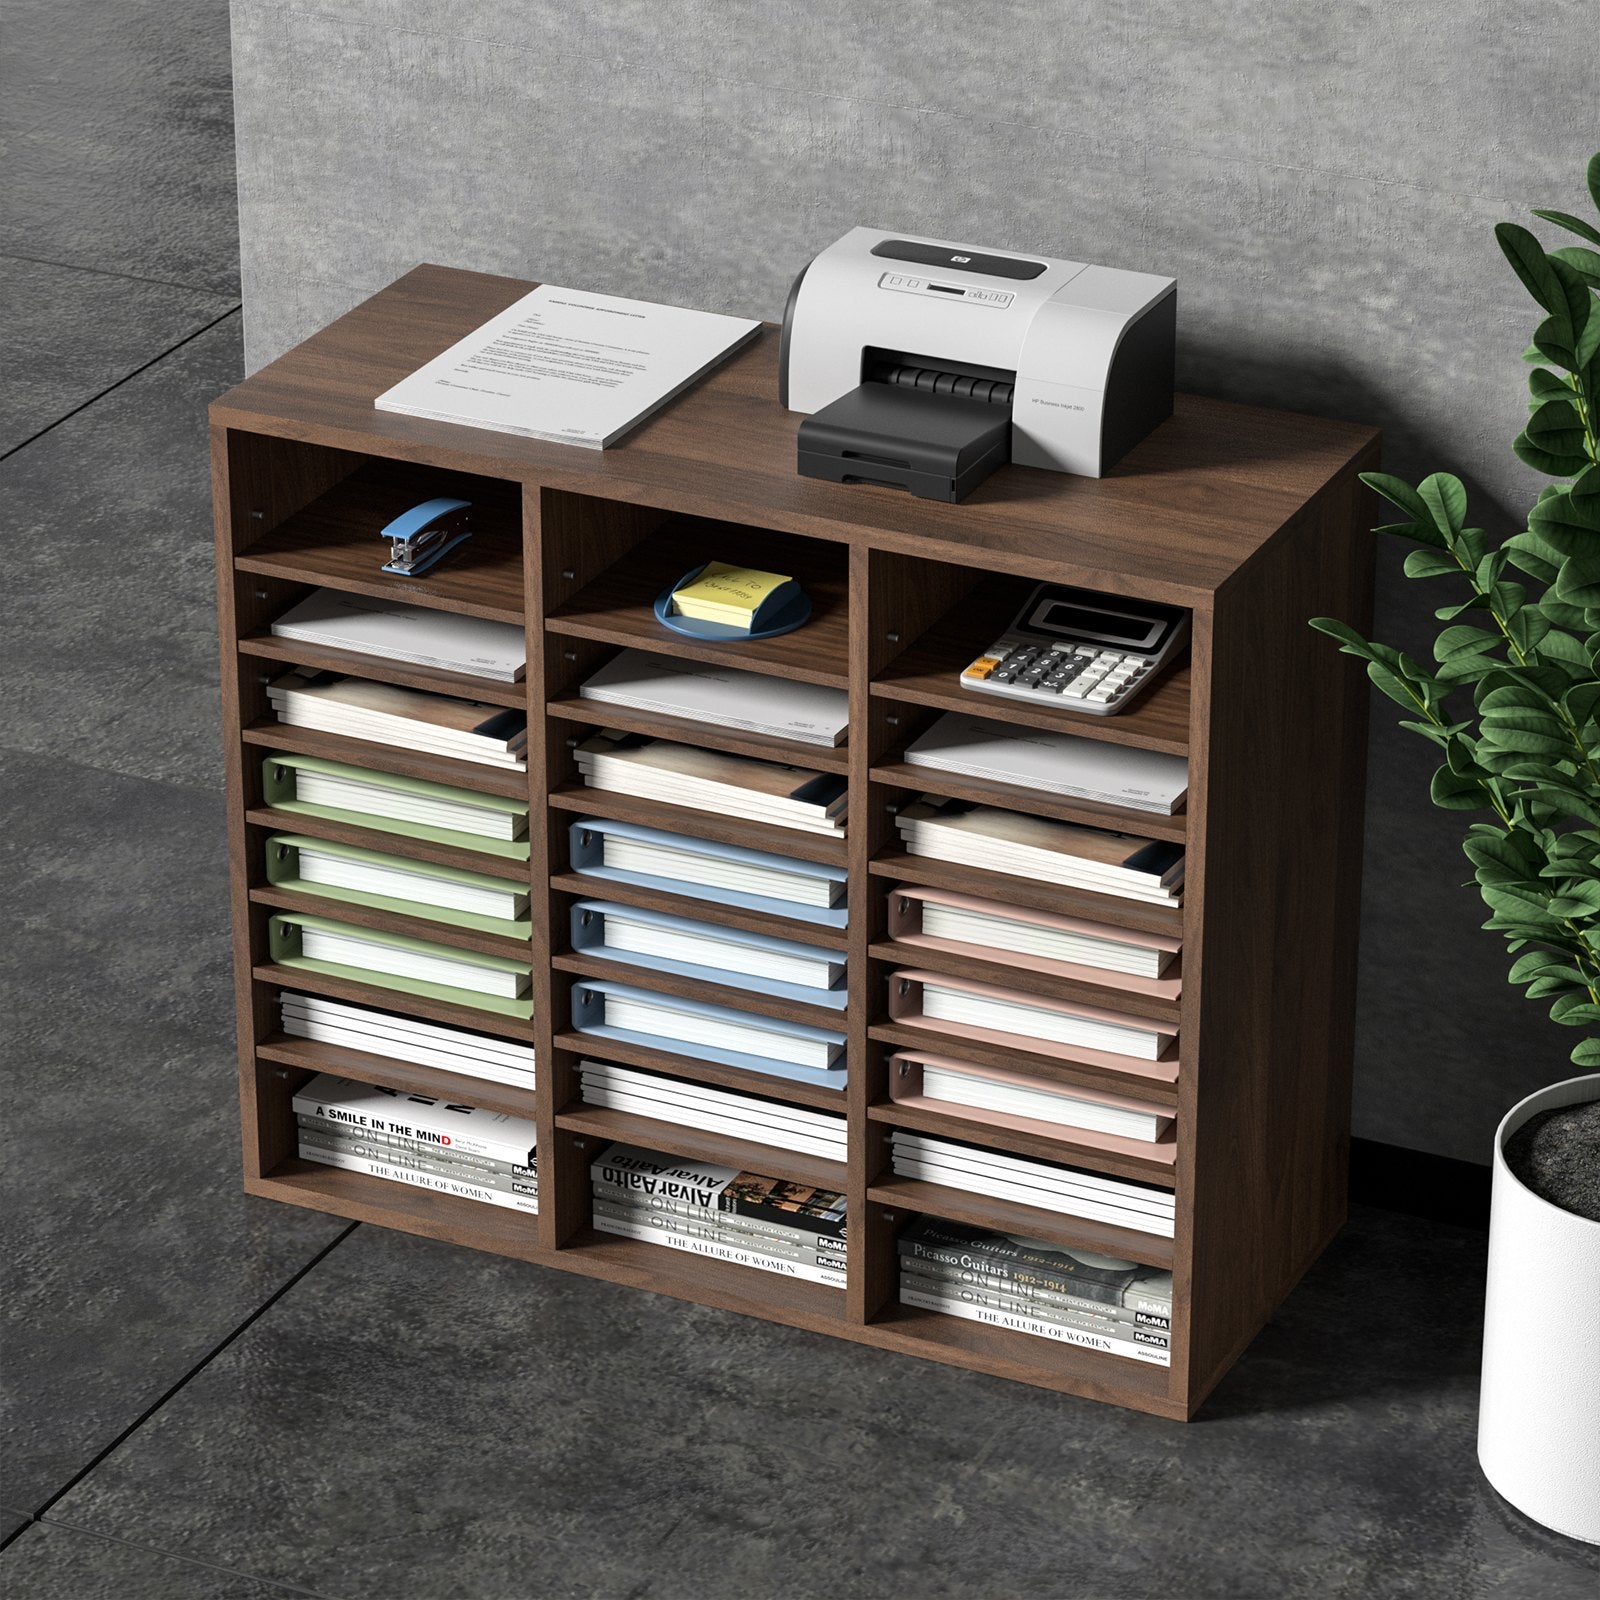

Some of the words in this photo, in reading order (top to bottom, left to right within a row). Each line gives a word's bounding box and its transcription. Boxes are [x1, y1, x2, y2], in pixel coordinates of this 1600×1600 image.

[316, 1105, 325, 1117] A
[328, 1108, 367, 1127] SMILE
[371, 1118, 385, 1131] IN
[388, 1122, 412, 1137] THE
[416, 1129, 451, 1146] MIND
[352, 1126, 379, 1143] ON
[386, 1133, 426, 1153] LINE
[354, 1145, 379, 1160] ON
[387, 1152, 427, 1171] LINE
[513, 1165, 537, 1178] MoM
[611, 1154, 669, 1175] Aalto
[368, 1164, 391, 1177] THE
[392, 1170, 433, 1187] ALLURE
[435, 1179, 450, 1191] OF
[450, 1184, 493, 1201] WOMEN
[513, 1184, 538, 1196] MoM
[666, 1168, 724, 1188] Alvar
[651, 1196, 677, 1213] ON
[686, 1204, 729, 1224] LINE
[651, 1216, 677, 1231] ON
[686, 1223, 728, 1244] LINE
[923, 1228, 968, 1245] Picasso
[970, 1240, 1018, 1257] Guitars
[665, 1235, 690, 1248] THE
[691, 1242, 733, 1260] ALLURE
[735, 1252, 751, 1263] OF
[751, 1256, 796, 1274] WOMEN
[818, 1238, 847, 1252] MoMA
[817, 1257, 847, 1270] MoMA
[914, 1243, 958, 1265] Picasso
[960, 1254, 1009, 1278] Guitars
[961, 1270, 988, 1287] ON
[998, 1279, 1041, 1299] LINE
[961, 1290, 988, 1306] ON
[998, 1298, 1042, 1318] LINE
[1137, 1300, 1169, 1316] MoMA
[976, 1309, 1000, 1323] THE
[1002, 1317, 1046, 1334] ALLURE
[1048, 1327, 1064, 1339] OF
[1066, 1331, 1111, 1349] WOMEN
[1136, 1313, 1168, 1329] MoMA
[1135, 1333, 1167, 1347] MoMA
